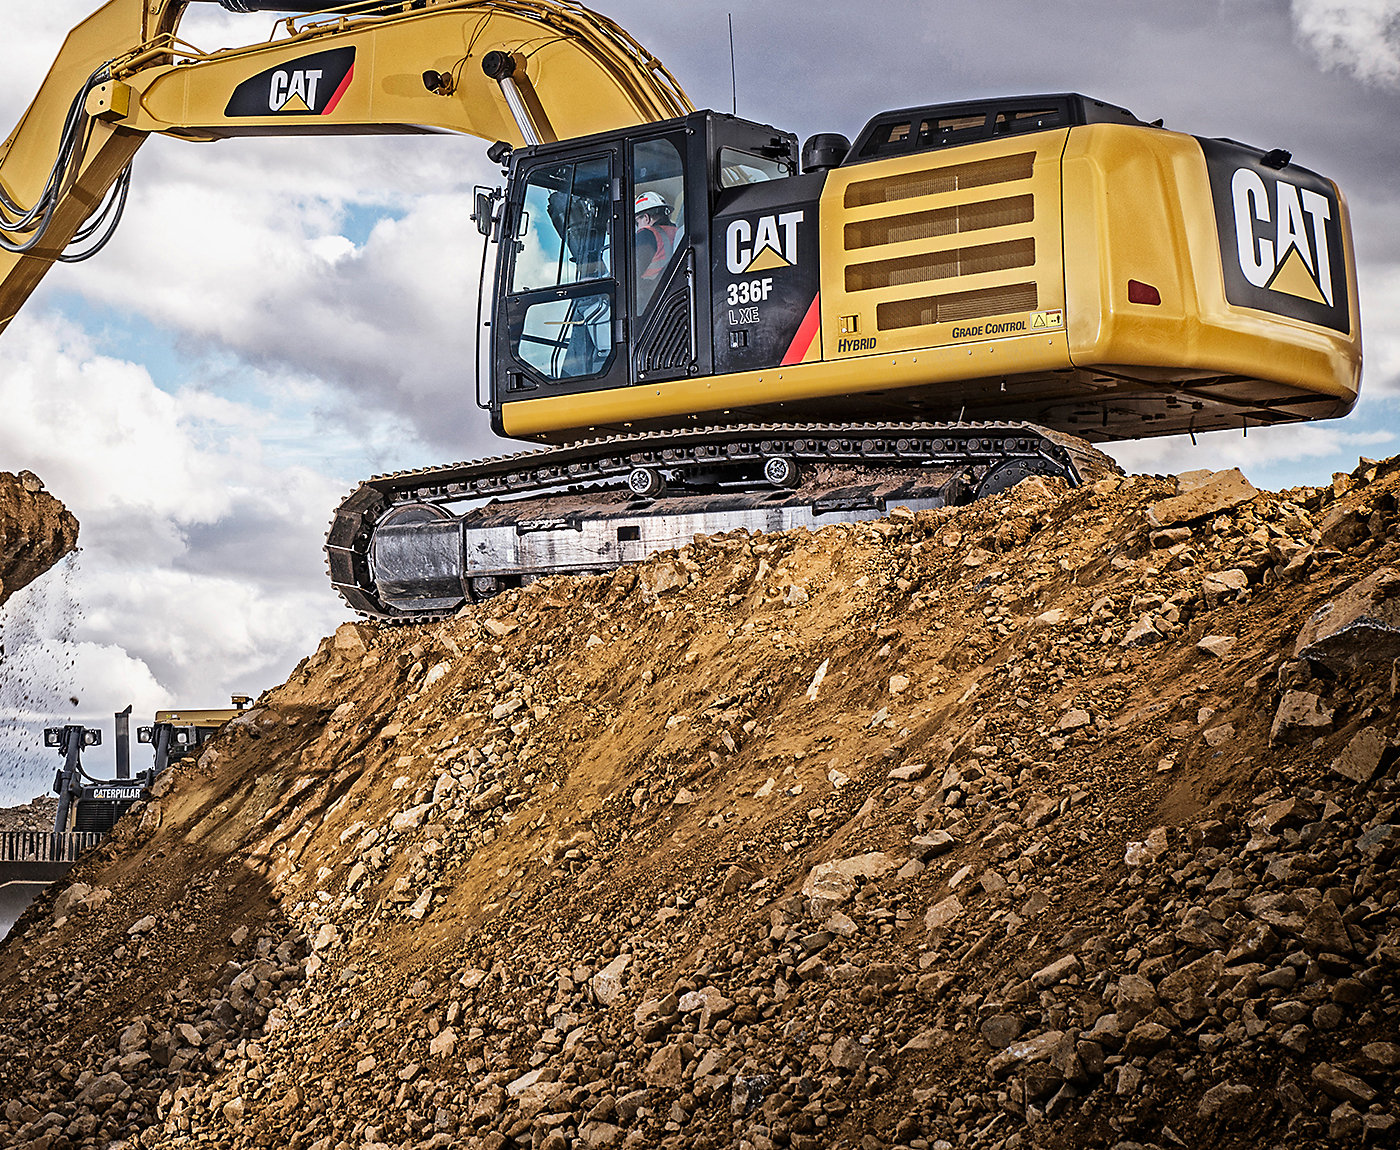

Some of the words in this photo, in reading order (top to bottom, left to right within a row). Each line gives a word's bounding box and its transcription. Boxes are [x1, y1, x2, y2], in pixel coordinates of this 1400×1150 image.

[269, 69, 322, 112] CAT
[726, 210, 804, 274] CAT
[1231, 167, 1334, 308] CAT
[727, 277, 773, 306] 336F
[952, 325, 983, 339] GRADE
[985, 320, 1027, 335] CONTROL
[838, 337, 877, 353] HYBRID
[93, 788, 141, 799] CATERPILLAR
